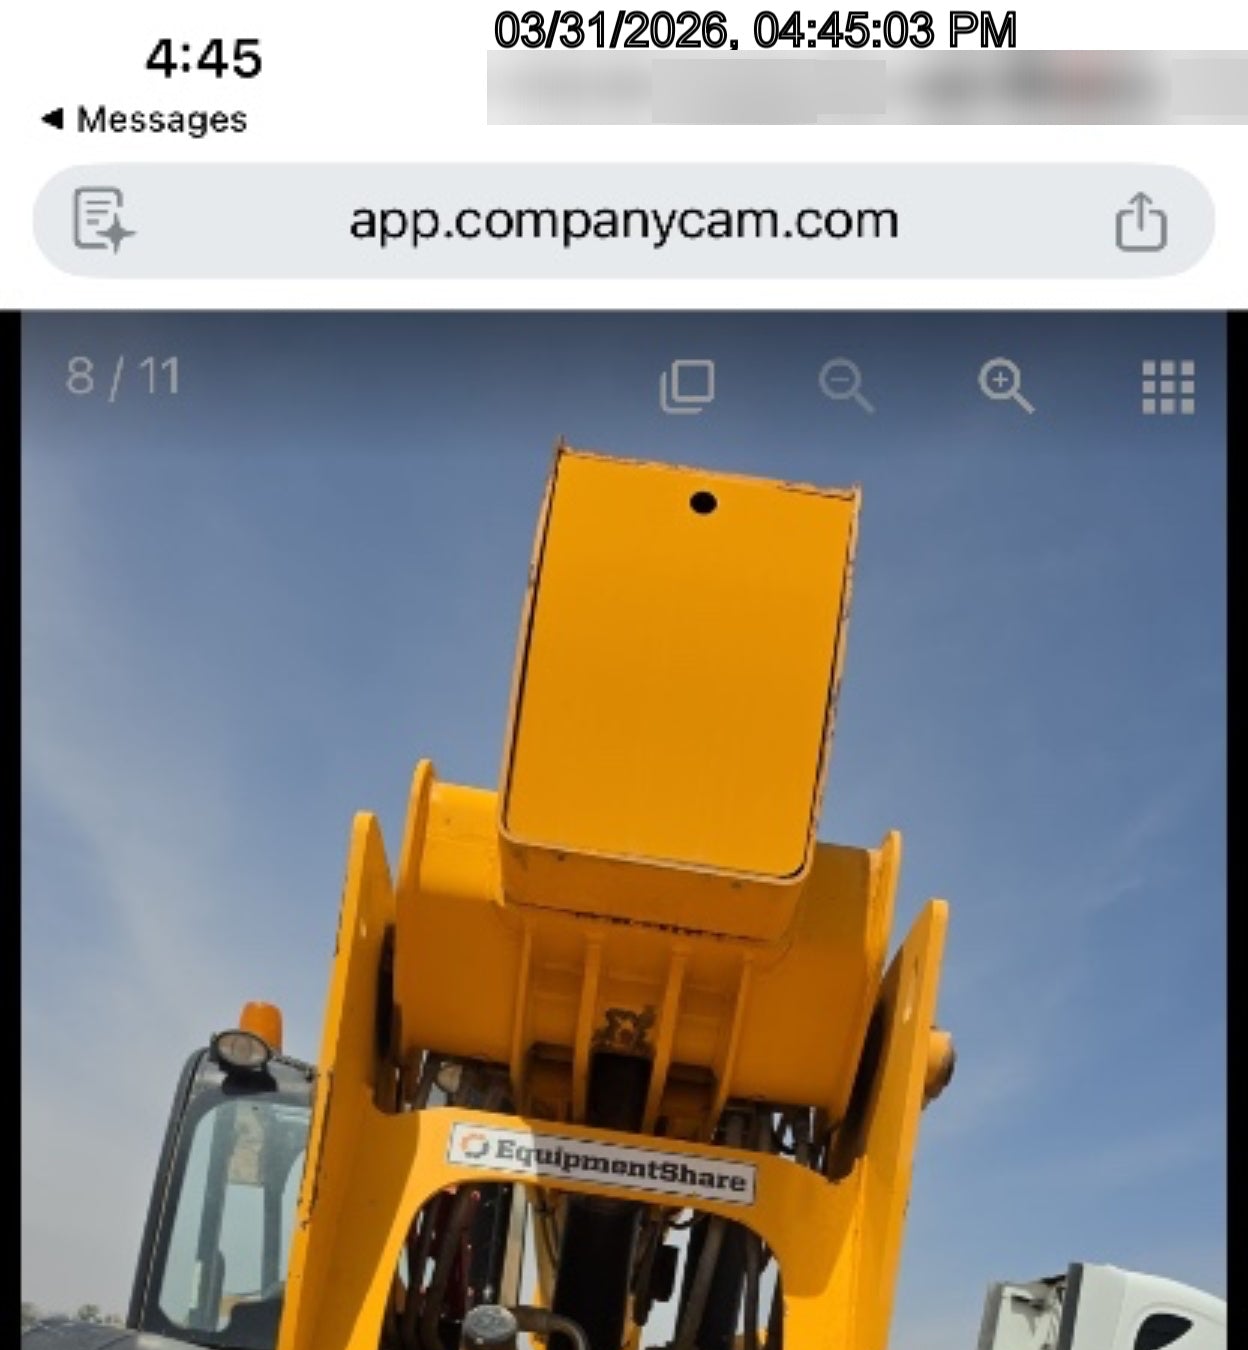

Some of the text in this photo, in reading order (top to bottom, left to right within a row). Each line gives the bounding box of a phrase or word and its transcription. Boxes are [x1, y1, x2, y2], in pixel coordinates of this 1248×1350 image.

[146, 39, 261, 78] 4:45
[78, 106, 246, 138] Messages
[350, 206, 899, 250] app.companycam.com
[66, 355, 179, 403] 8 / 11
[494, 1138, 748, 1192] EquipmentShare
